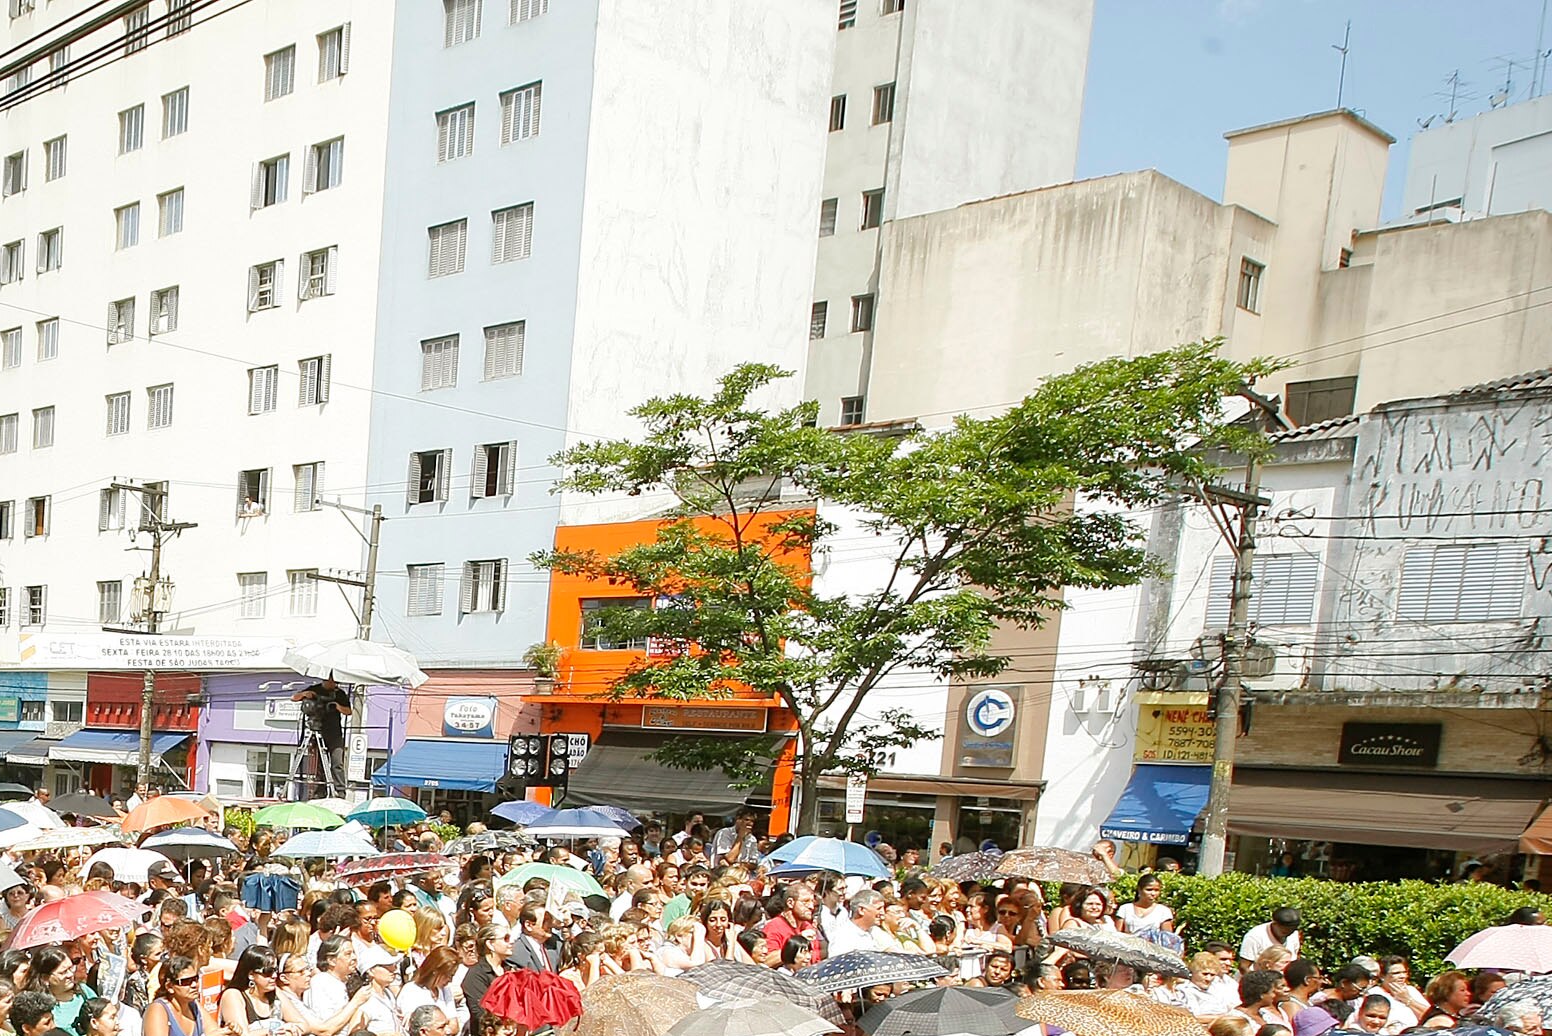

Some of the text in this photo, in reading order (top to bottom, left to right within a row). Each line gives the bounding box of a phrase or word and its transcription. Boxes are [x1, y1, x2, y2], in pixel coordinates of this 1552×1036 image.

[120, 638, 140, 646] ESTA
[101, 648, 129, 656] SEXTA
[135, 649, 160, 657] FEIRA
[185, 649, 200, 657] DAS
[128, 659, 153, 667] FESTA
[155, 659, 167, 667] DE
[168, 658, 185, 667] SÃO
[355, 739, 362, 751] E
[1351, 743, 1389, 755] Cacau
[1141, 832, 1148, 841] &
